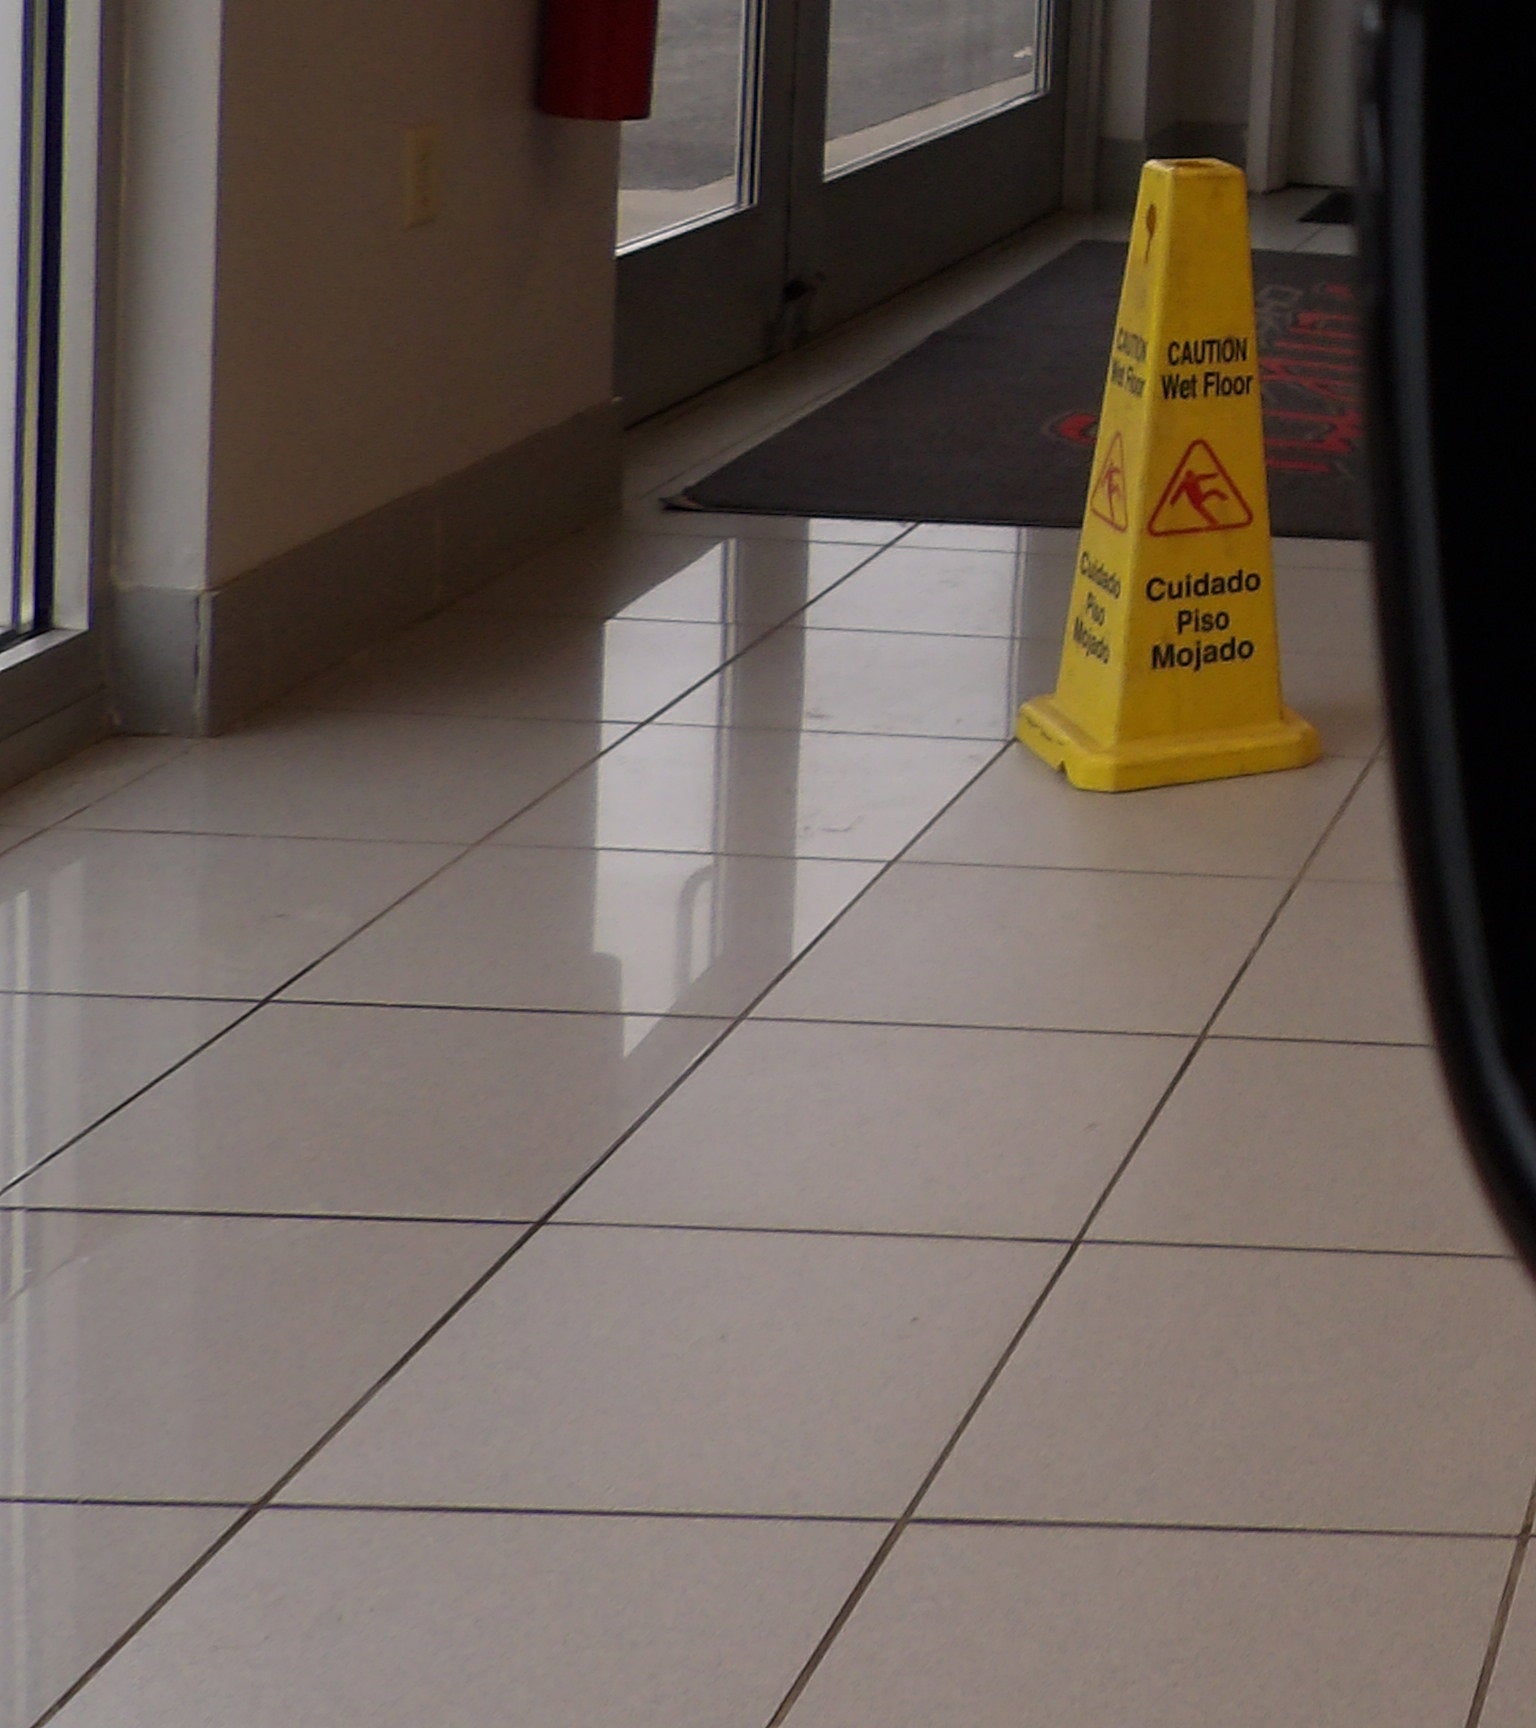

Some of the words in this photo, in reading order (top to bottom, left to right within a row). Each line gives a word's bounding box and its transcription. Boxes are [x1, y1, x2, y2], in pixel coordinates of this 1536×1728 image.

[1167, 335, 1248, 367] CAUTION
[1161, 373, 1198, 400] Wet
[1203, 371, 1254, 398] Floor
[1145, 569, 1261, 603] Cuidado
[1177, 609, 1230, 635] Piso
[1151, 636, 1254, 672] Mojado
